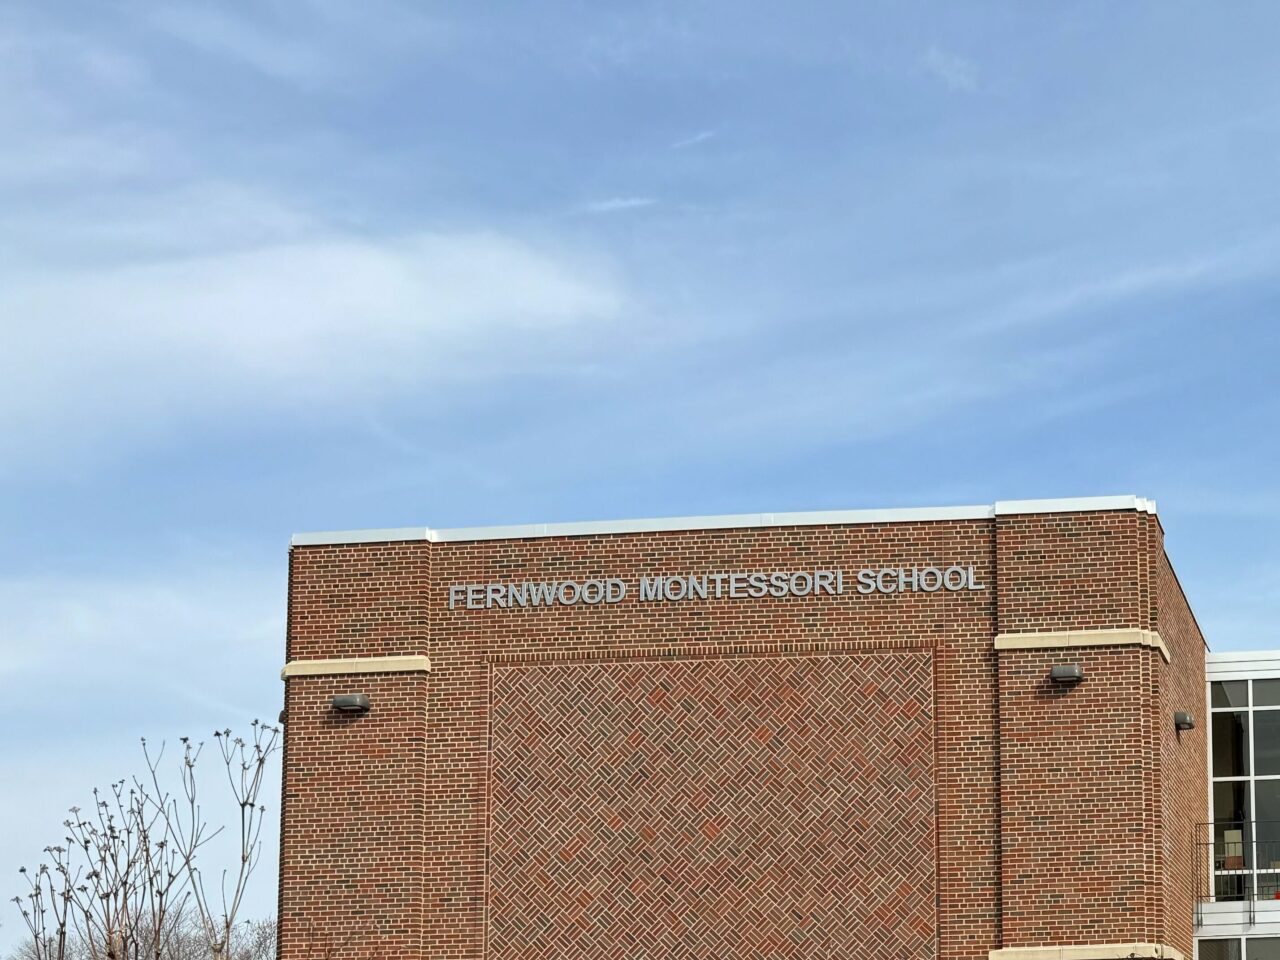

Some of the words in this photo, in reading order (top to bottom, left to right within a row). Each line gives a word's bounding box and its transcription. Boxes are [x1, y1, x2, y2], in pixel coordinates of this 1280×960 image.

[449, 578, 626, 610] FERNWOOD
[639, 570, 843, 602] MONTESSORI
[857, 566, 985, 594] SCHOOL
